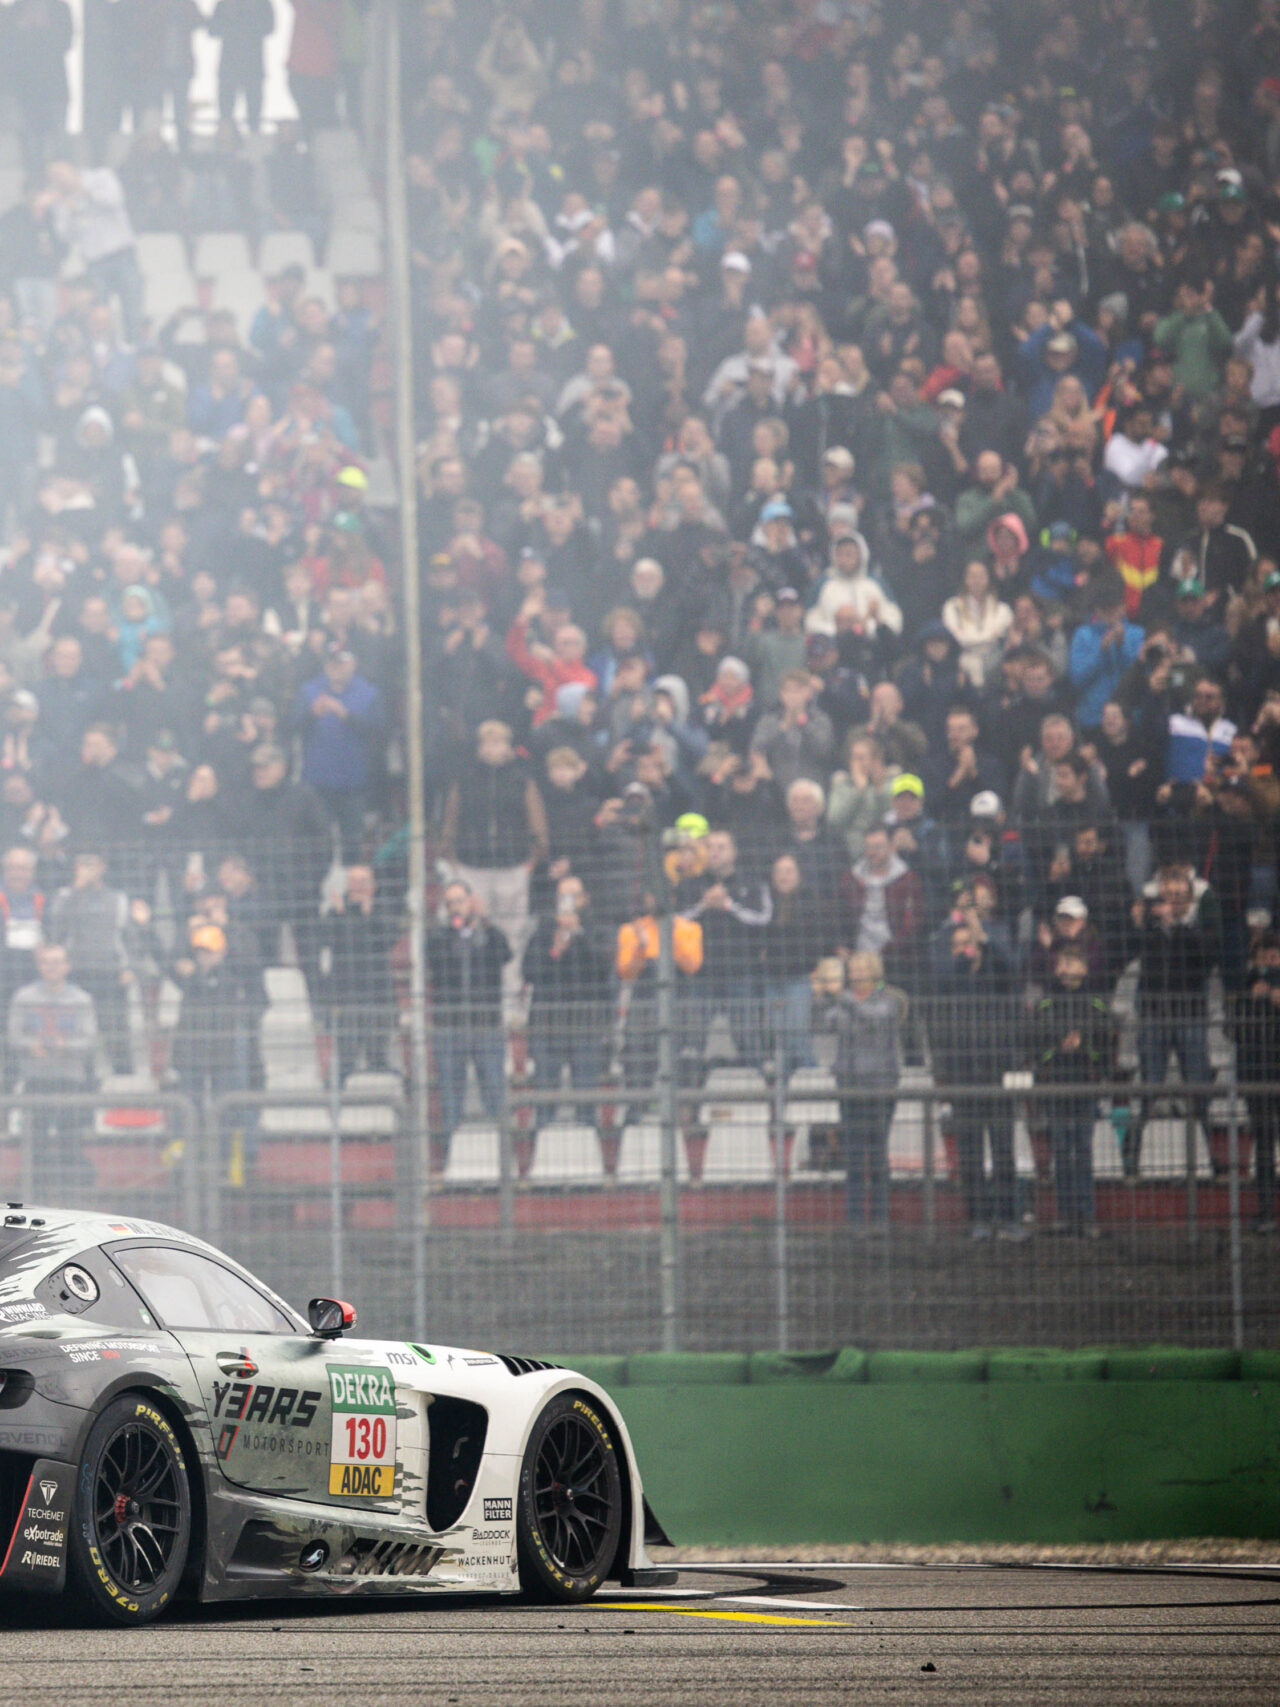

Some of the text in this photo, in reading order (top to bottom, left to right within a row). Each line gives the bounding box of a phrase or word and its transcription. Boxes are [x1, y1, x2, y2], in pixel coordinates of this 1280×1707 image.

[4, 1303, 46, 1314] WINWARD
[11, 1311, 53, 1322] RACING
[60, 1341, 106, 1353] DEFINING
[69, 1350, 100, 1363] SINCE
[386, 1352, 417, 1366] msi
[331, 1372, 394, 1406] DEKRA
[346, 1417, 386, 1459] 130
[243, 1434, 329, 1457] MOTORSPORT
[341, 1466, 382, 1495] ADAC
[484, 1500, 511, 1509] MANN
[28, 1507, 64, 1521] TECHEMET
[485, 1510, 511, 1519] FILTER
[36, 1553, 60, 1567] RIEDEL
[458, 1555, 511, 1566] WACKENHUT
